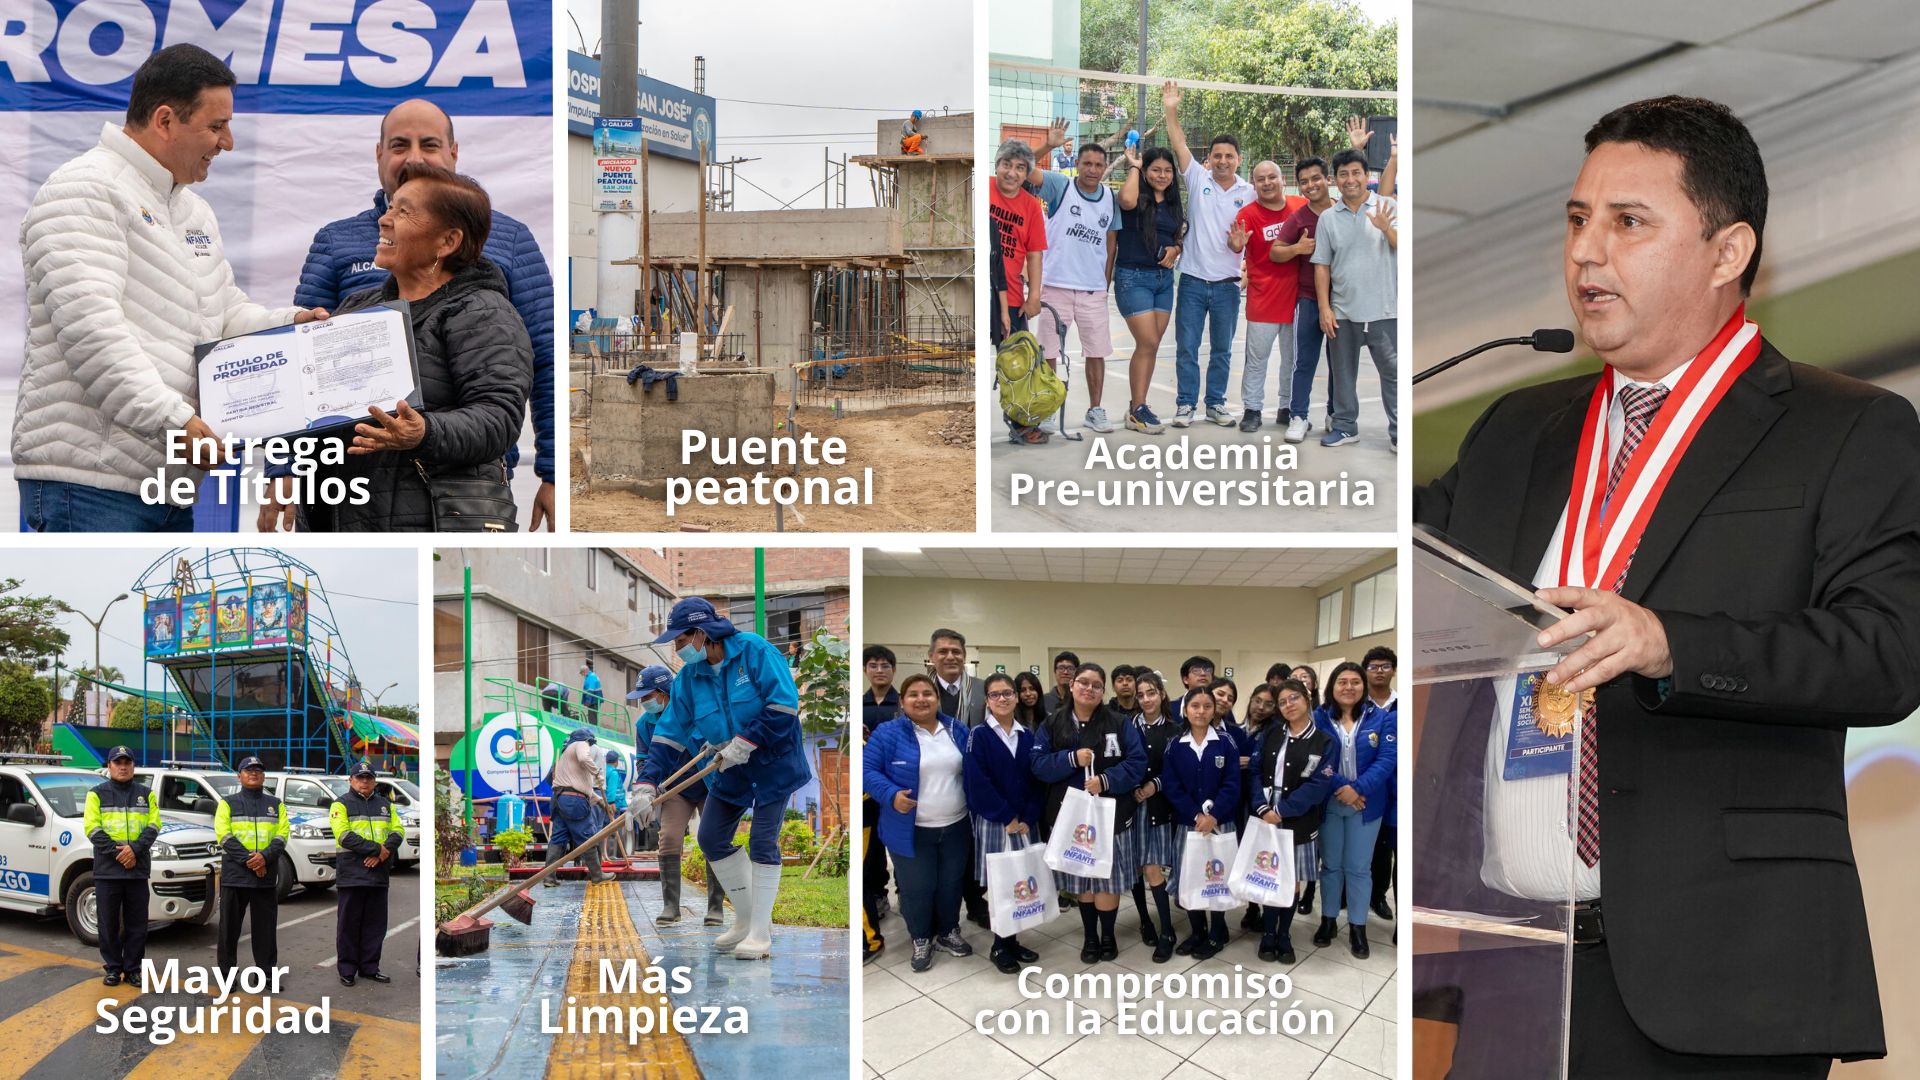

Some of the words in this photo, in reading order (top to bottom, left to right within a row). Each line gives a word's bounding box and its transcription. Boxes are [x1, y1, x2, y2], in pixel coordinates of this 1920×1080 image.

[662, 130, 669, 138] en
[990, 203, 1025, 227] ROLLING
[216, 355, 263, 372] TÍTULO
[266, 350, 284, 360] DE
[213, 358, 288, 382] PROPIEDAD
[1031, 665, 1039, 675] S
[1225, 668, 1233, 677] S
[1104, 733, 1121, 757] A
[1522, 744, 1566, 756] PARTICIPANTE
[61, 832, 71, 844] 01
[1064, 849, 1097, 866] INFANTE
[1246, 873, 1280, 891] INFANTE
